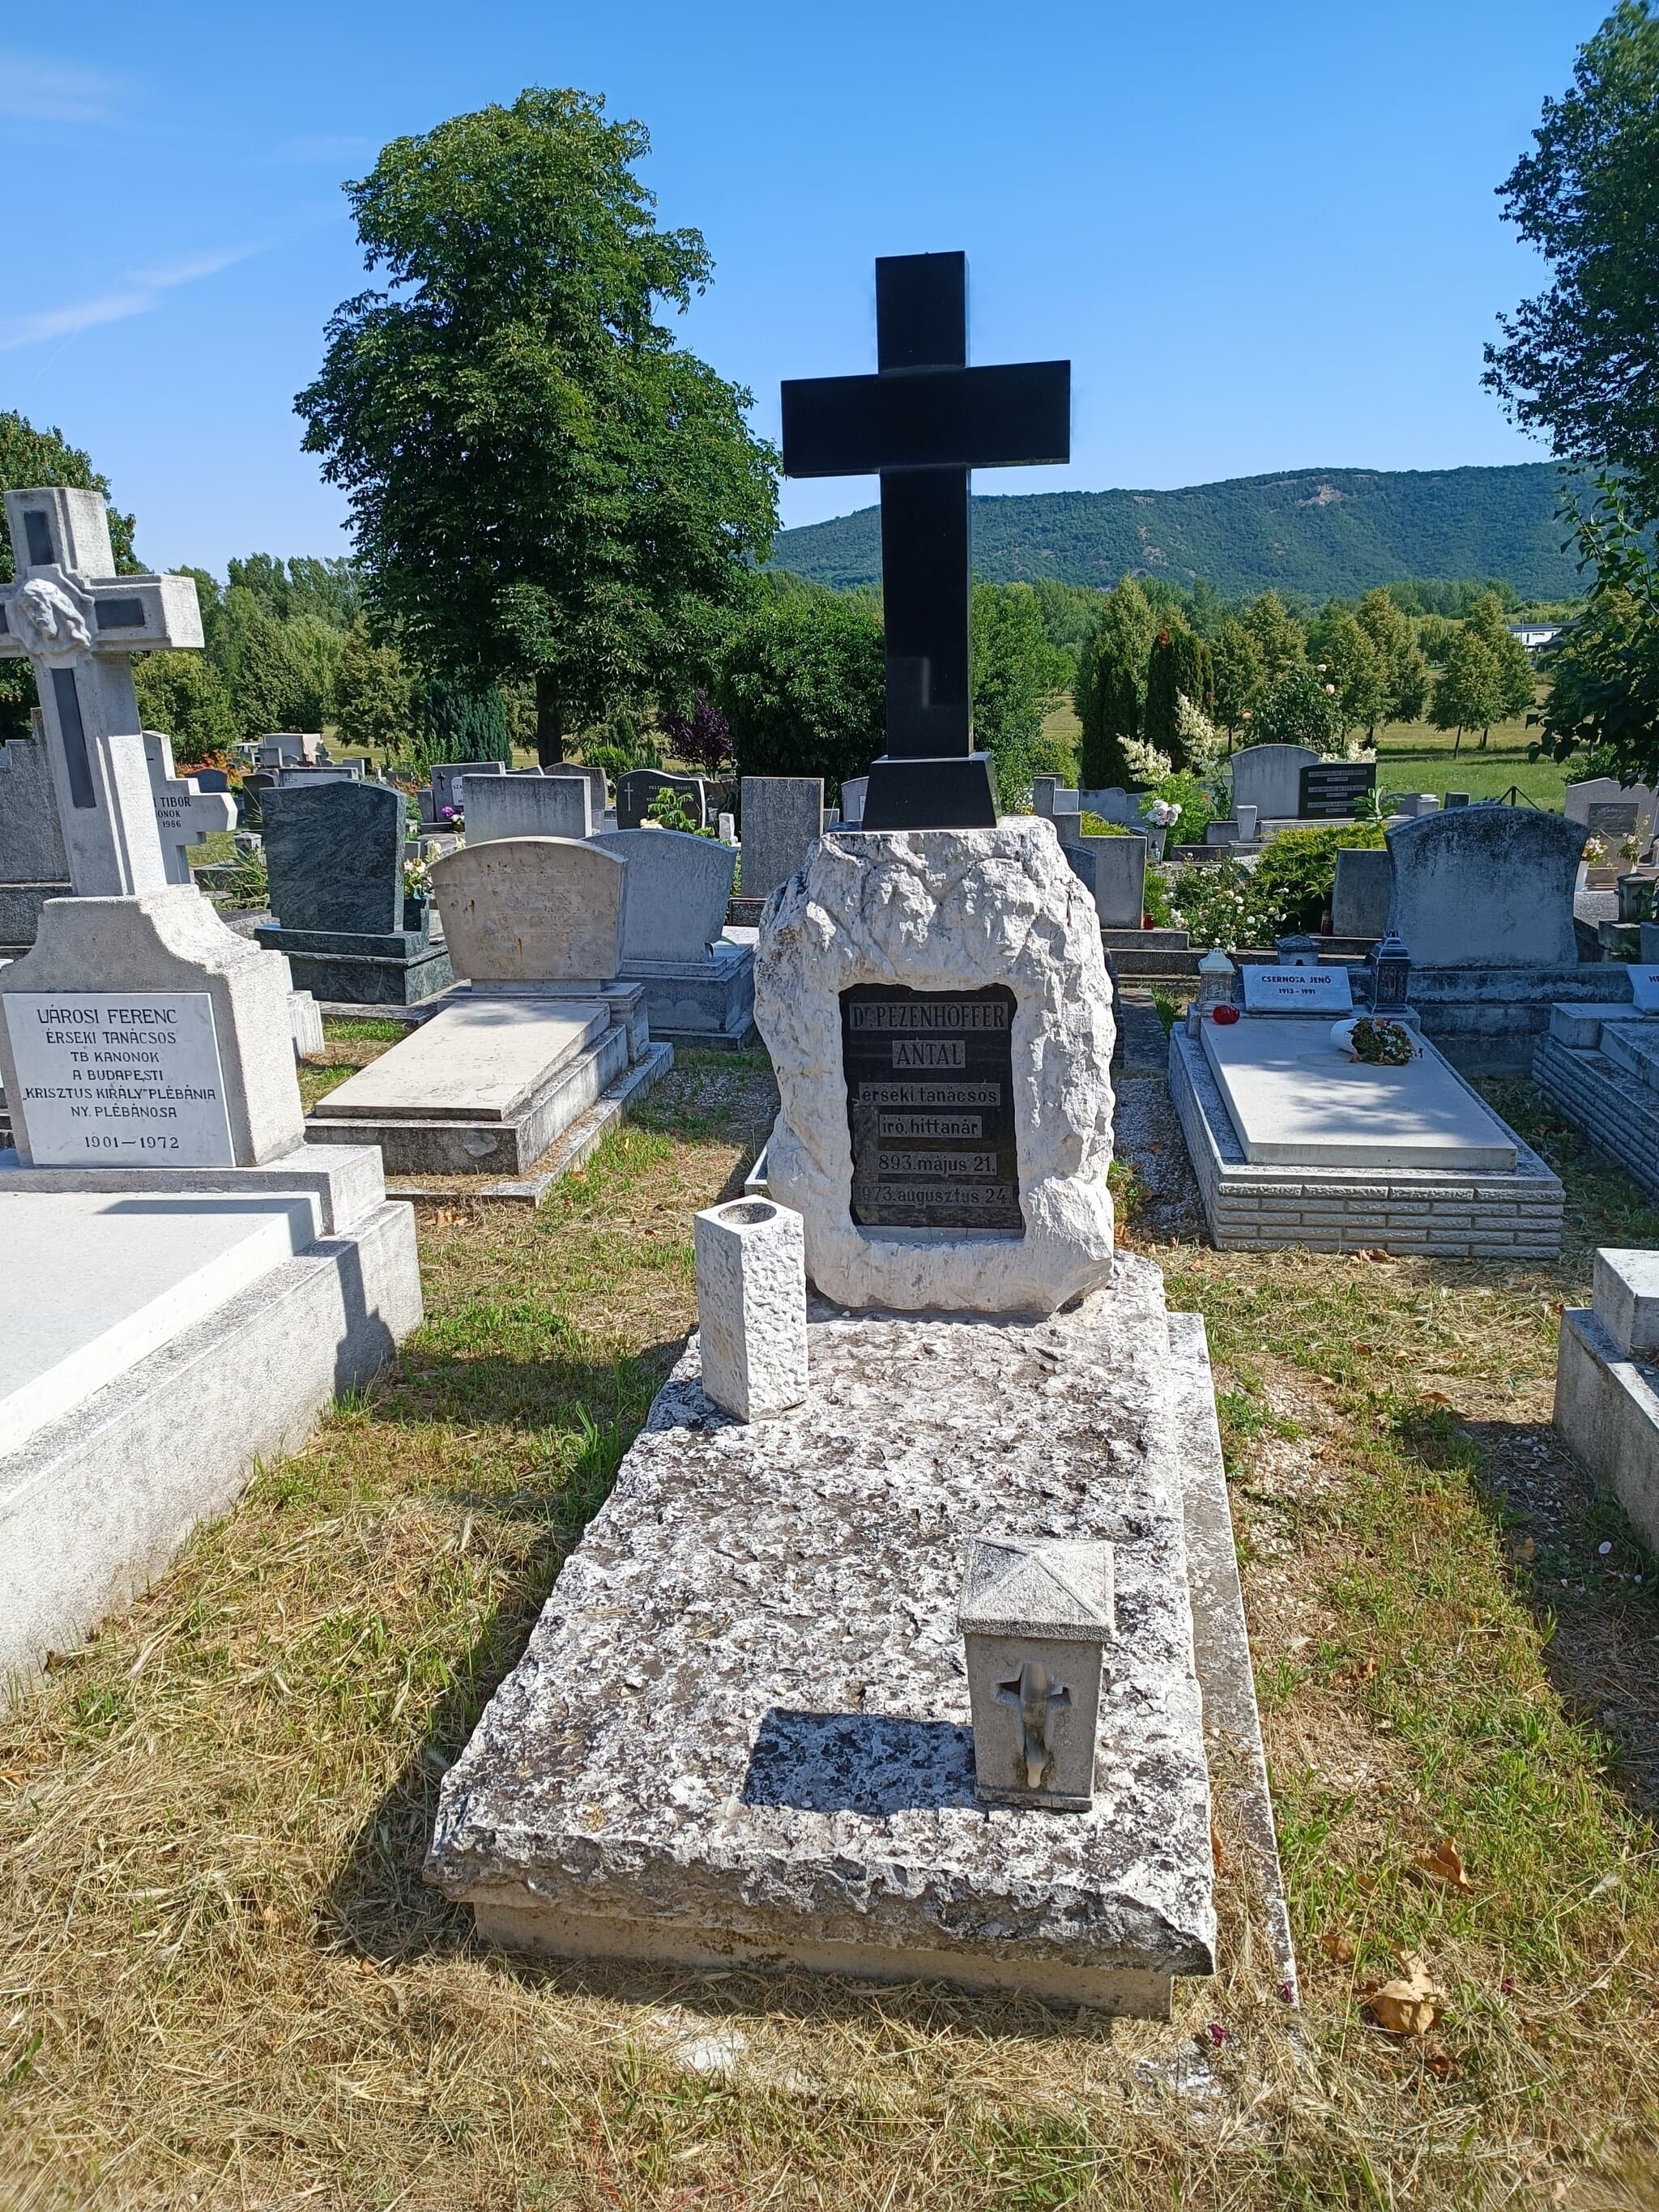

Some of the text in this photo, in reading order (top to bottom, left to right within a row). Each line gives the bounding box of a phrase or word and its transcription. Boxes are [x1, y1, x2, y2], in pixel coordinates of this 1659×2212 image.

[160, 796, 191, 808] TIBOR
[156, 810, 181, 818] ONOK
[36, 1004, 178, 1024] VÁROSI FERENC
[876, 1004, 1005, 1028] PEZENHOFFER
[46, 1028, 177, 1044] ÉRSEKI TANÁCSOS
[70, 1051, 161, 1063] TB KANONOK
[897, 1043, 962, 1065] ANTAL
[73, 1070, 164, 1081] A BUDAPESTI
[863, 1085, 997, 1103] érseki tanácsos
[71, 1103, 178, 1118] NY. PLÉBÁNOSA
[974, 1156, 996, 1171] 21.
